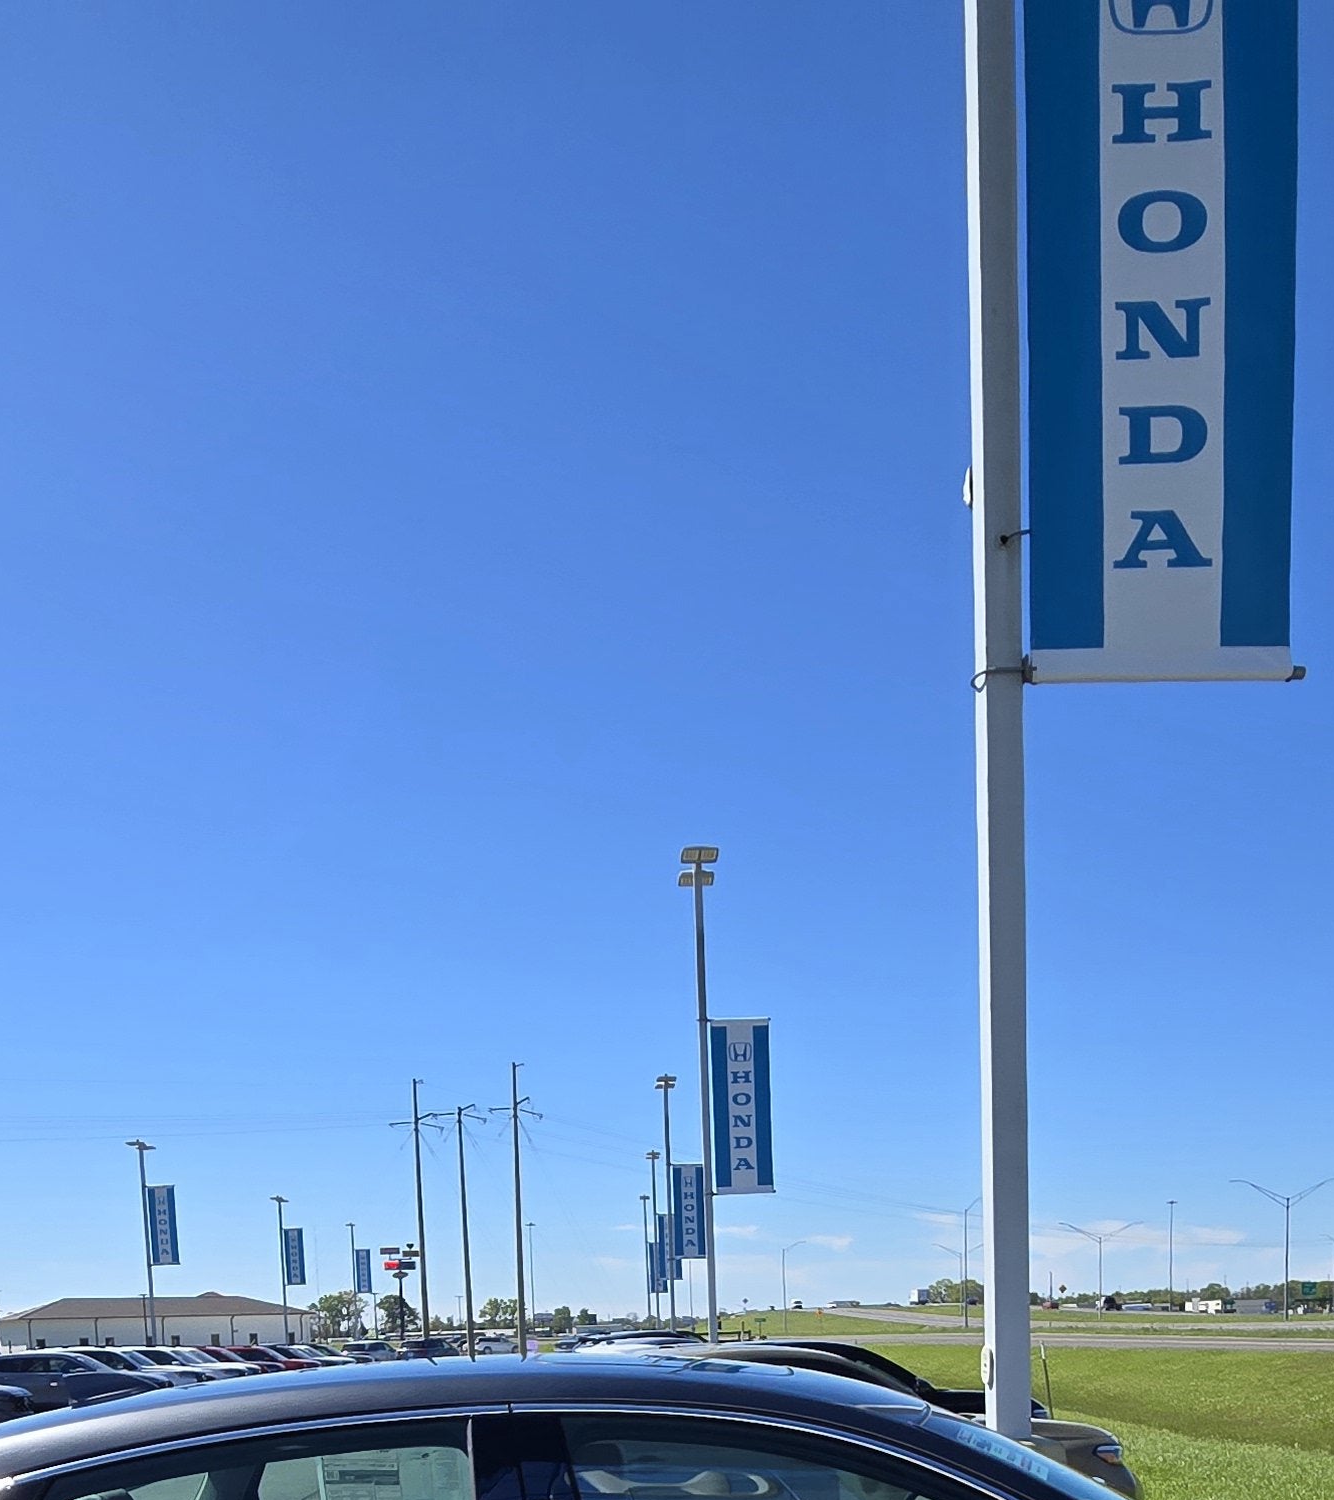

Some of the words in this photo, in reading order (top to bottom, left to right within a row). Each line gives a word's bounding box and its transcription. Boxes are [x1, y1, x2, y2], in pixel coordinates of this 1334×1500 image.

[1111, 79, 1214, 569] HONDA
[730, 1070, 755, 1171] HONDA
[683, 1191, 696, 1247] HONDA
